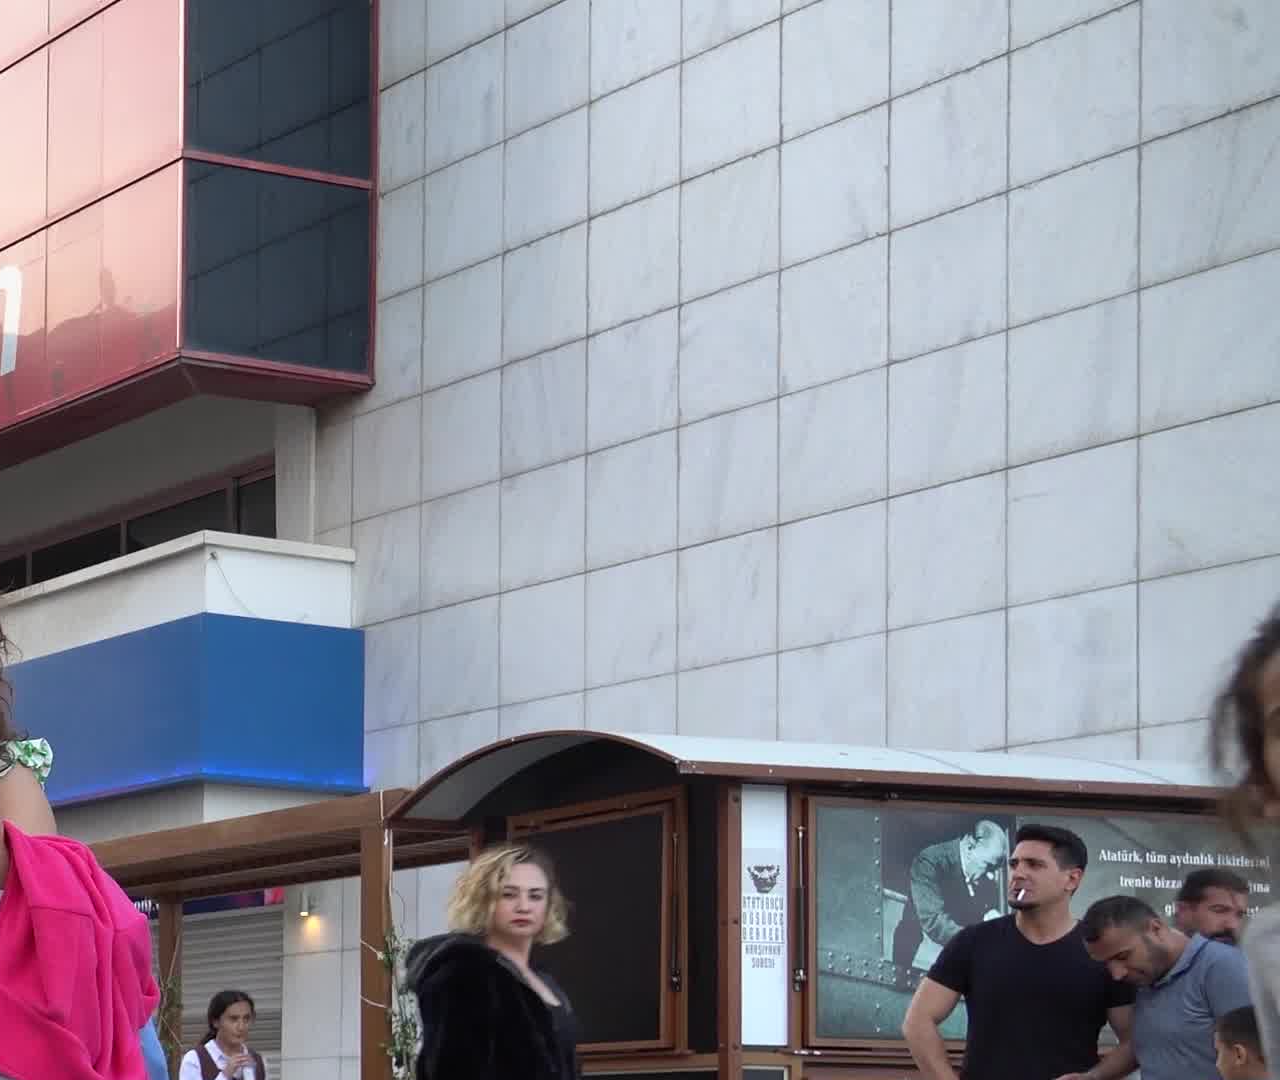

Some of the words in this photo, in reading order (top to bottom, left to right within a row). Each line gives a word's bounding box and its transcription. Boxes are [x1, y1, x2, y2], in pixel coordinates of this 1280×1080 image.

[1098, 848, 1143, 864] Atatürk,
[1145, 850, 1167, 864] tüm
[1169, 852, 1214, 868] aydınlık
[1120, 874, 1153, 889] trenle
[1154, 876, 1183, 889] bizza
